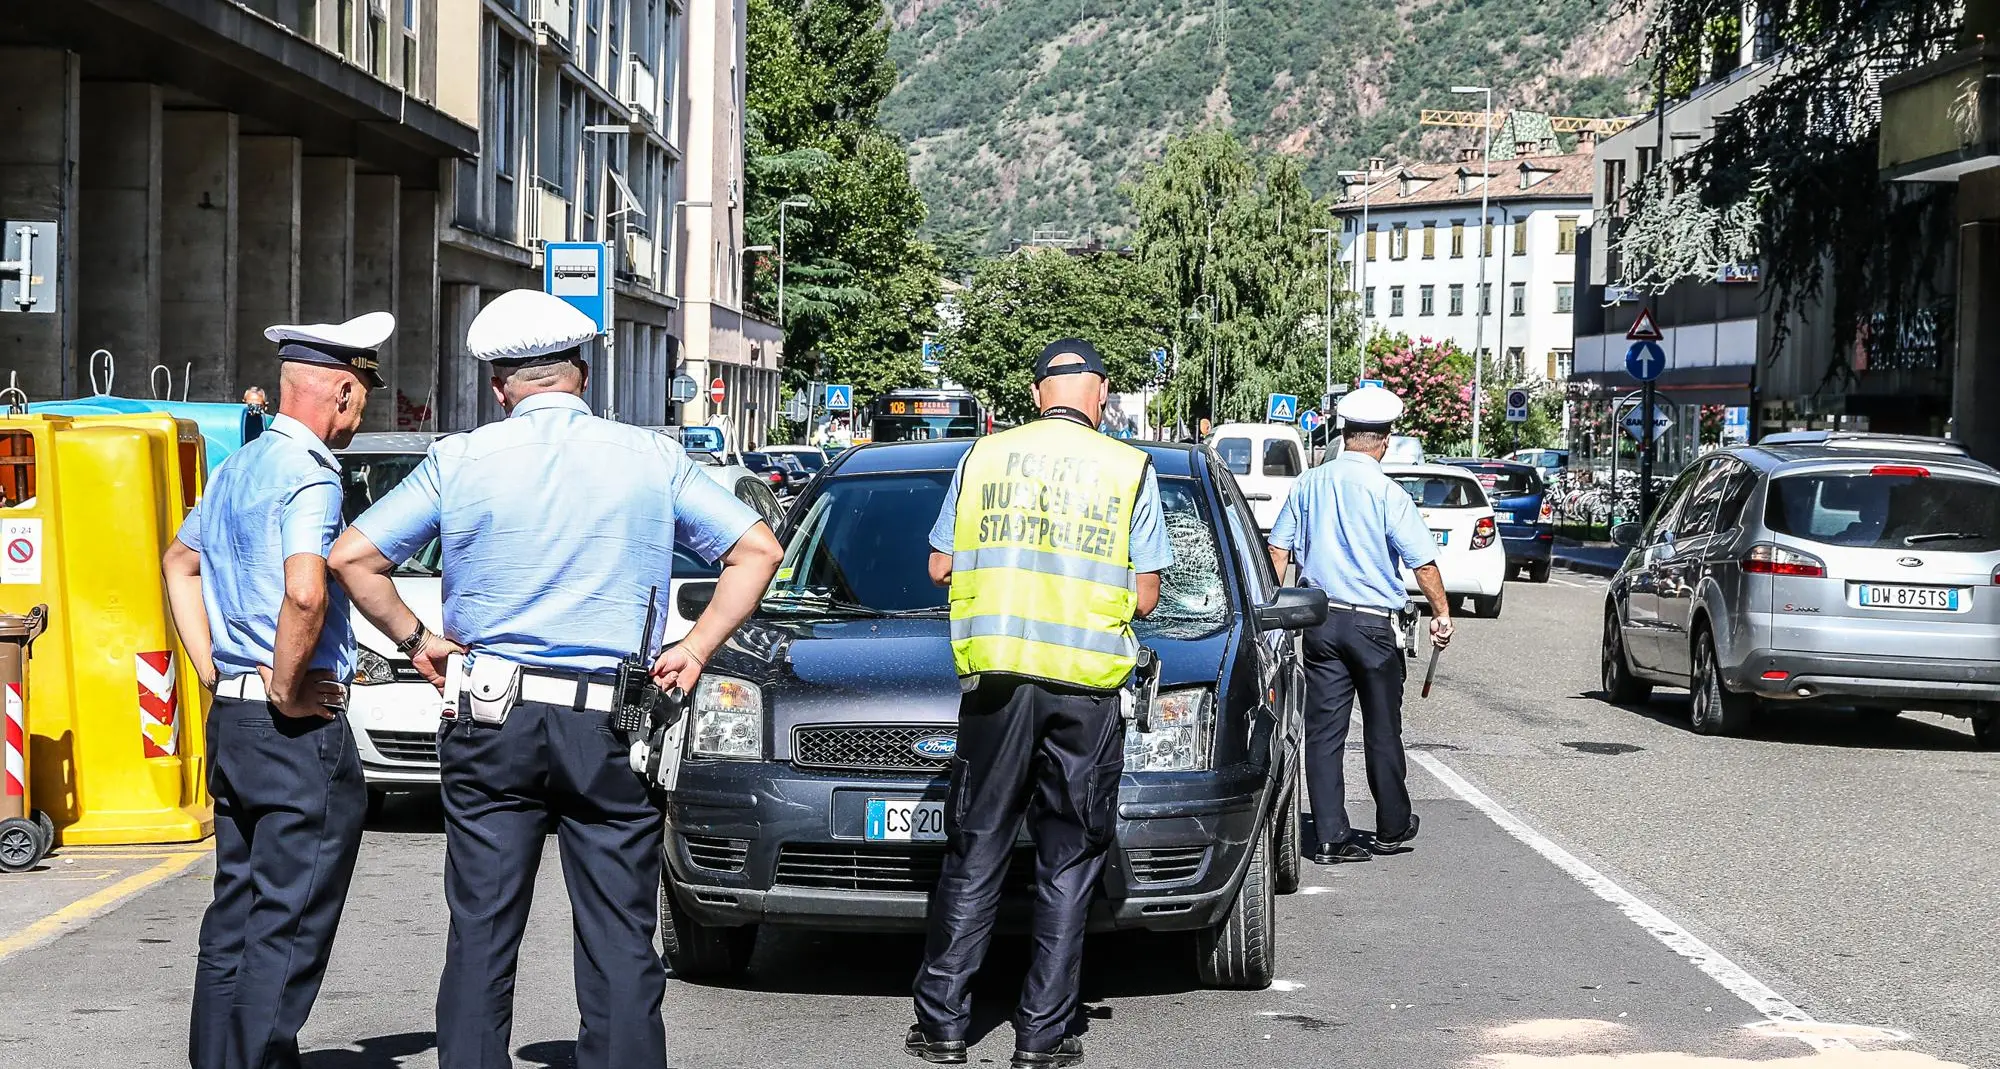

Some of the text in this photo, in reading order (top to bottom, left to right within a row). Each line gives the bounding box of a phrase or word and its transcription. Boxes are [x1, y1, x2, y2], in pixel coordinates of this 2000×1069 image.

[889, 401, 906, 415] 10B
[1044, 408, 1067, 416] Canon
[1626, 418, 1668, 427] BANMAT
[1872, 588, 1891, 603] DW
[1898, 589, 1947, 606] 875TS
[922, 740, 956, 752] Ford
[887, 808, 911, 832] CS
